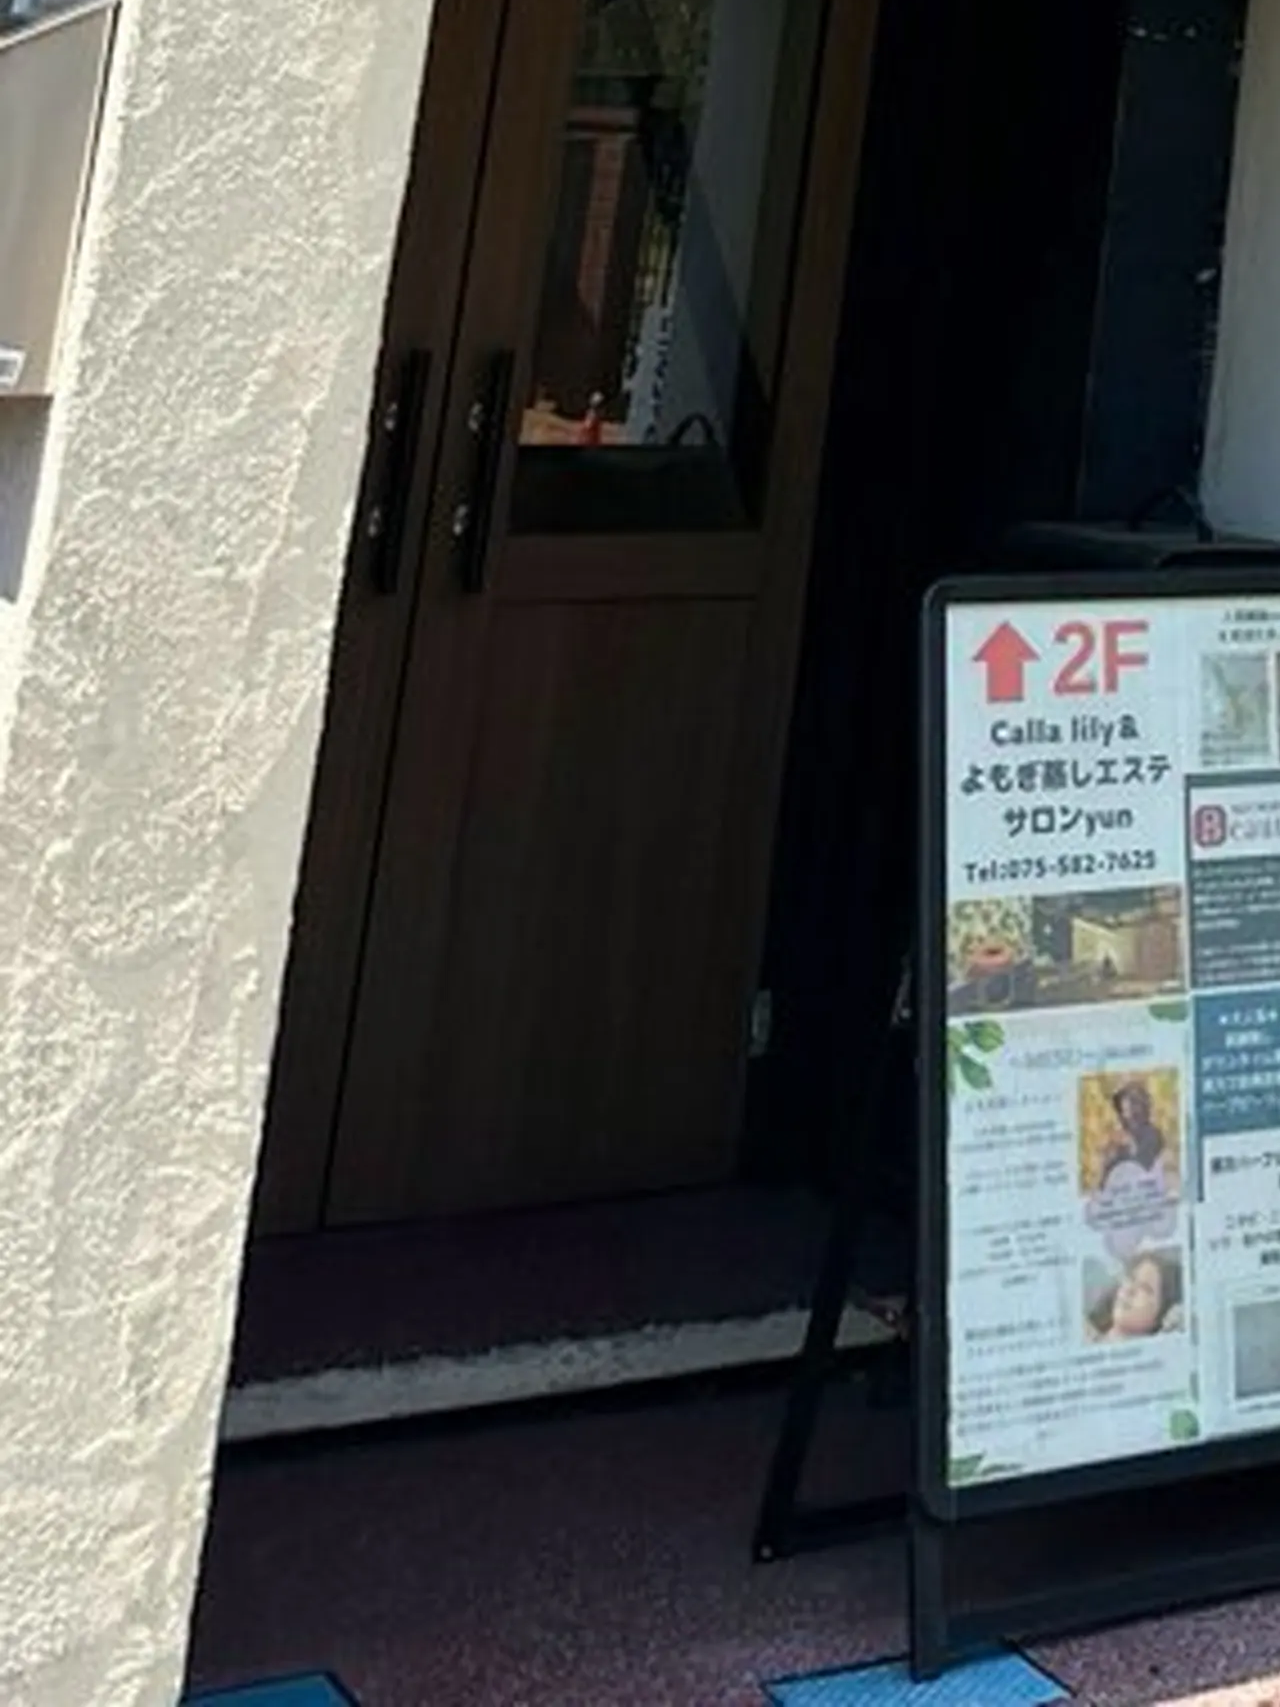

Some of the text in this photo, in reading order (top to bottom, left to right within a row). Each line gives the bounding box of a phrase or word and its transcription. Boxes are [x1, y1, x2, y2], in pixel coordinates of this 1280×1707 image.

[1049, 619, 1150, 697] 2F
[990, 718, 1062, 746] Calla
[960, 758, 1172, 795] よもぎ蒸しエステ
[1003, 803, 1134, 840] サロンyun
